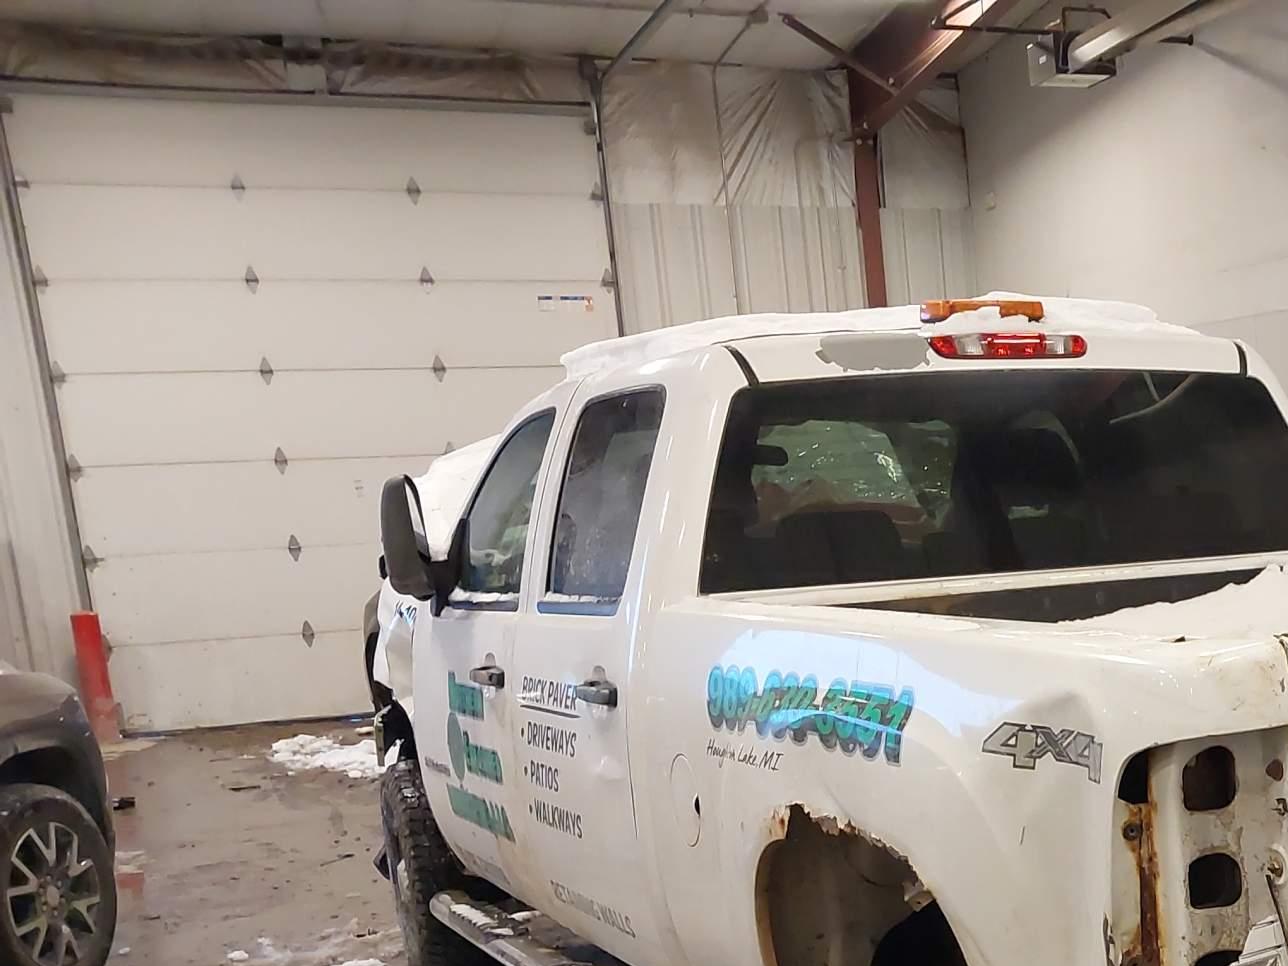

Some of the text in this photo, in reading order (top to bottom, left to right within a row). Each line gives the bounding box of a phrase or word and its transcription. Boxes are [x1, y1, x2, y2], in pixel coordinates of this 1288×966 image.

[521, 676, 577, 710] BRICK PAVER
[527, 721, 577, 757] DRIVEWAYS
[530, 759, 559, 793] PATIOS
[759, 750, 784, 771] MI
[534, 798, 583, 839] WALKWAYS
